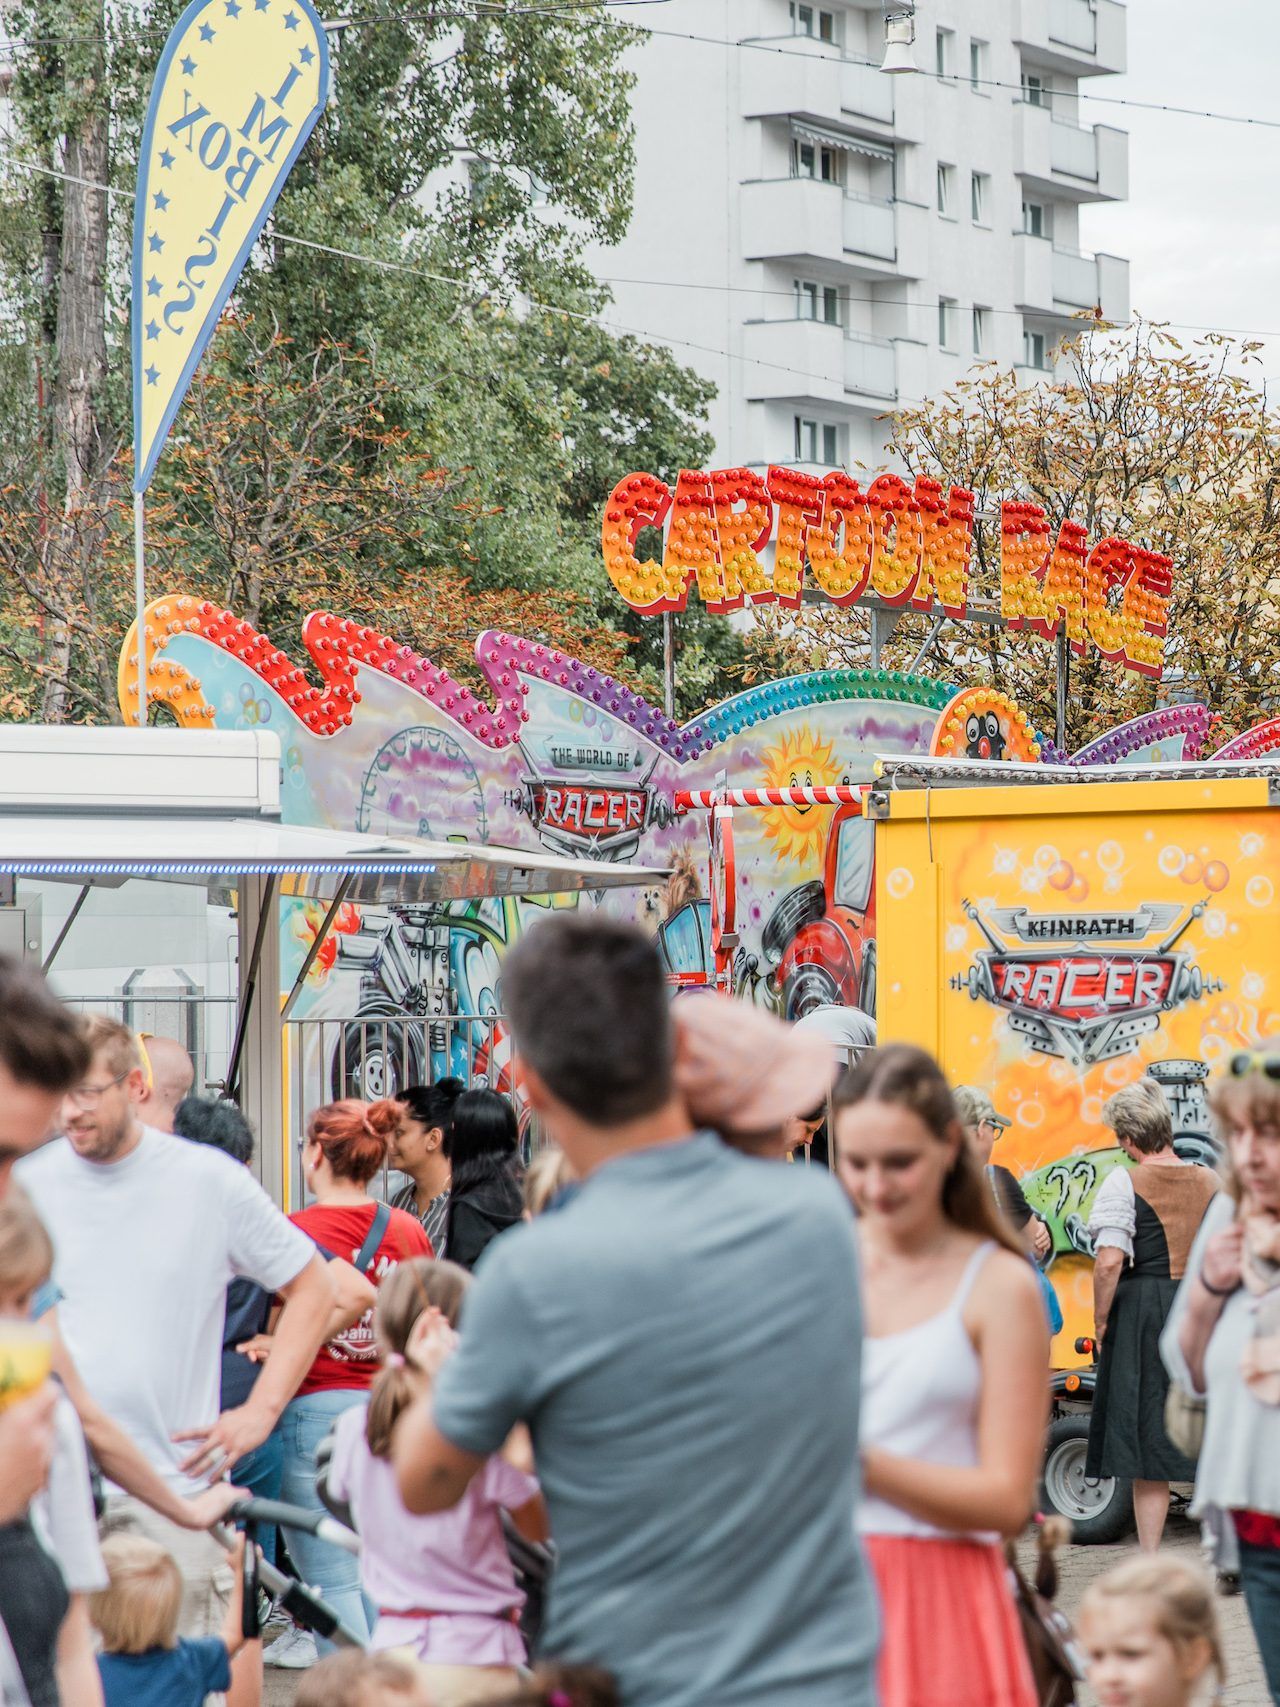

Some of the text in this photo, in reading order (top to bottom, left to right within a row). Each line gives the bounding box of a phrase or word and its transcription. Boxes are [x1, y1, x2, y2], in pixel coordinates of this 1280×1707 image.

[601, 464, 1174, 678] CARTOON RACE
[551, 747, 630, 768] THE WORLD OF
[544, 789, 642, 828] RACER
[1028, 917, 1135, 937] KEINRATH
[1003, 962, 1166, 1006] RACER
